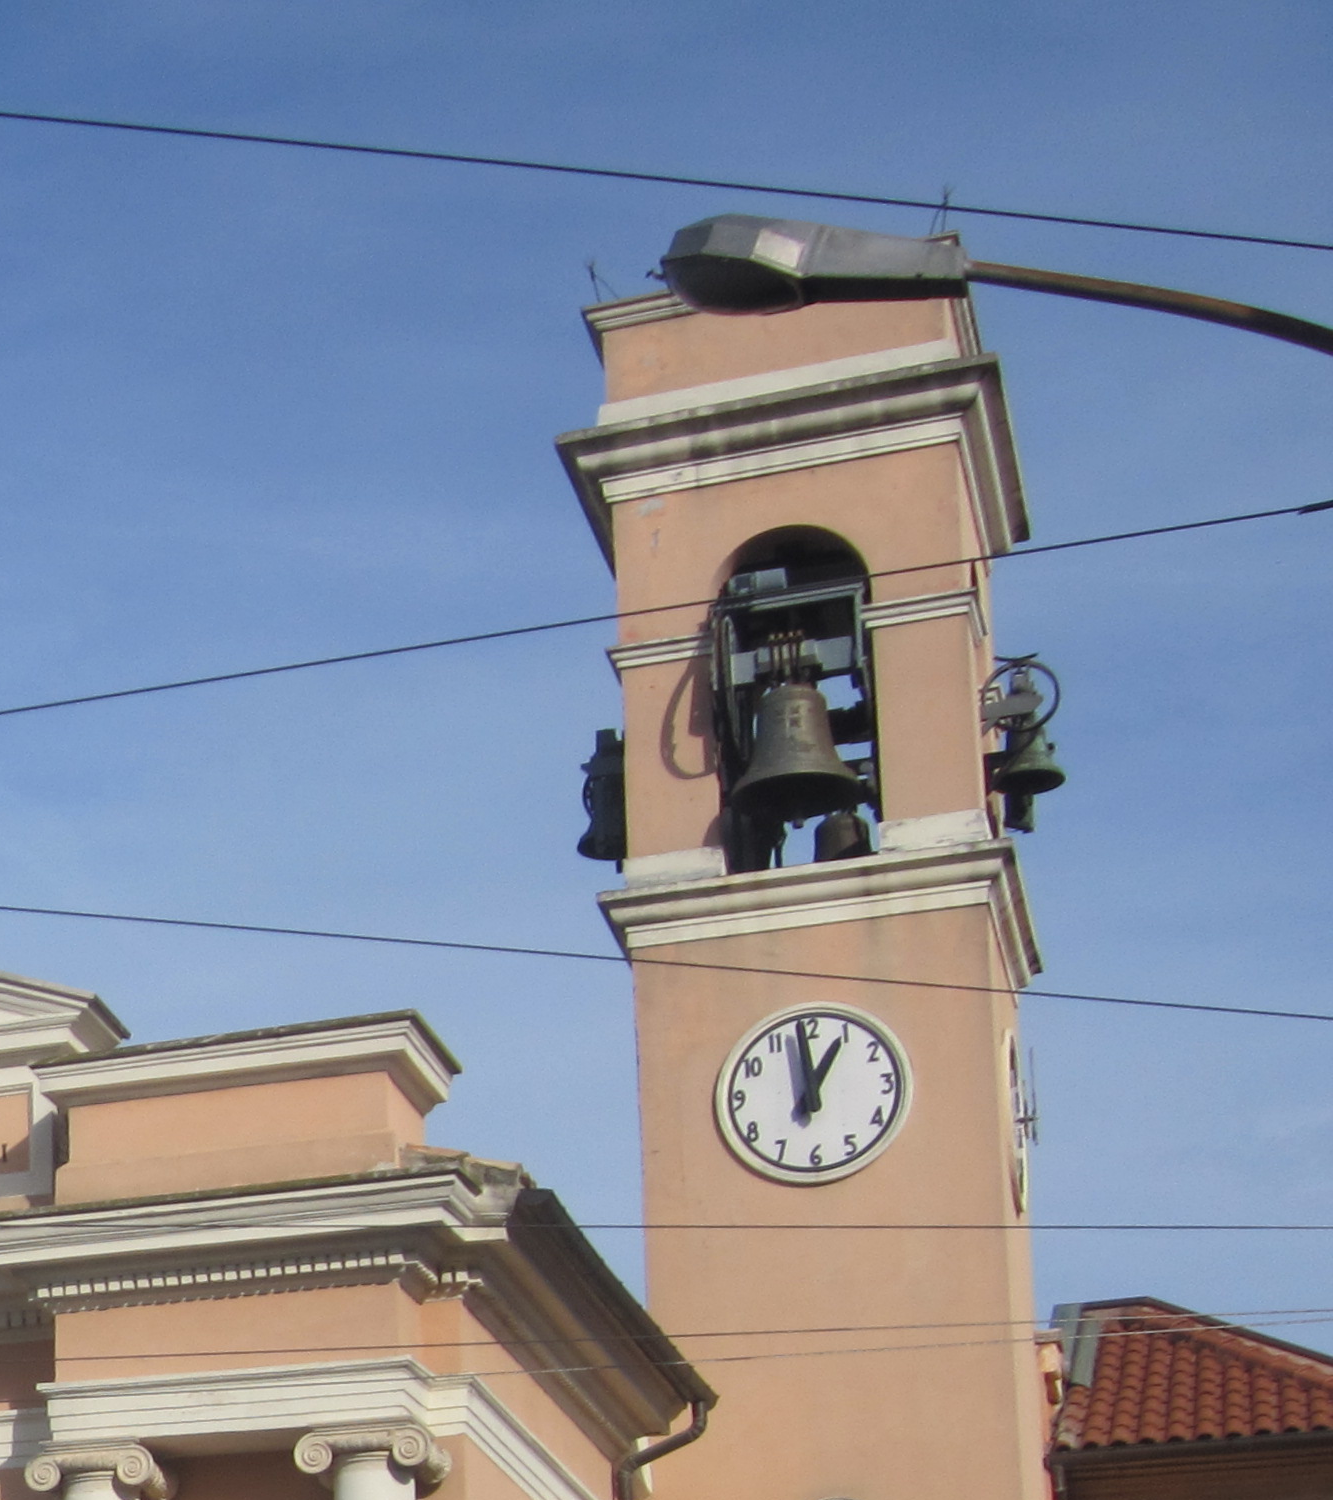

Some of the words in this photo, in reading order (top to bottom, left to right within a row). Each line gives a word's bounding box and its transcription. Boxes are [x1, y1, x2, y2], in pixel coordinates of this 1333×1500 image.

[842, 1023, 849, 1042] 1
[768, 1033, 782, 1053] 11
[867, 1042, 879, 1062] 2
[743, 1057, 762, 1078] 10
[880, 1073, 894, 1094] 3
[733, 1090, 746, 1110] 9
[870, 1106, 883, 1126] 4
[747, 1122, 758, 1142] 8
[775, 1139, 787, 1162] 7
[810, 1144, 822, 1165] 6
[844, 1135, 856, 1155] 5
